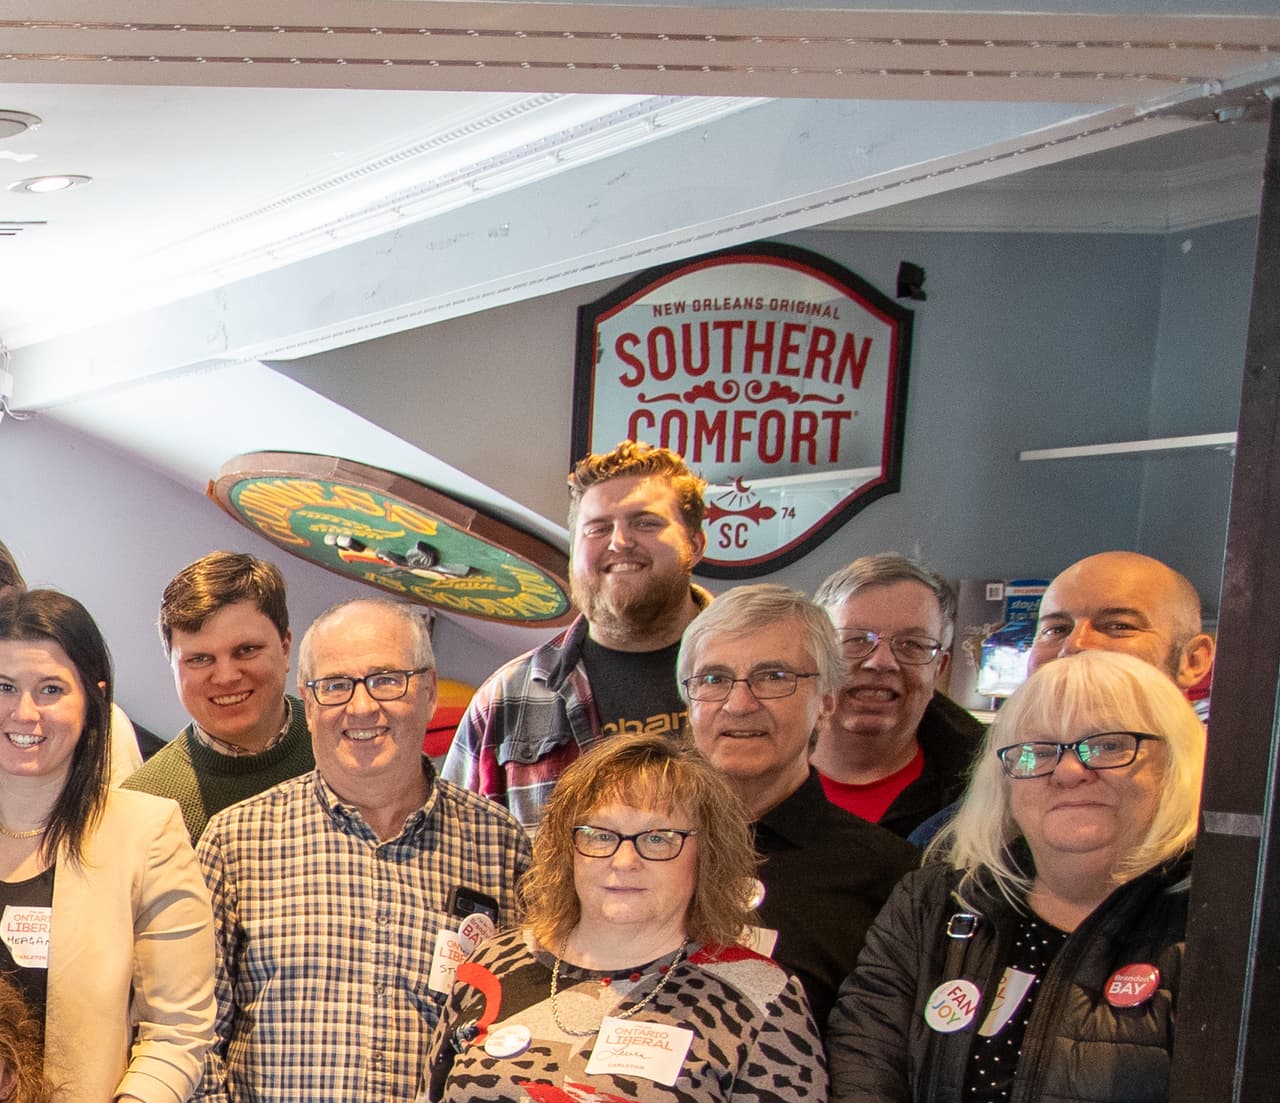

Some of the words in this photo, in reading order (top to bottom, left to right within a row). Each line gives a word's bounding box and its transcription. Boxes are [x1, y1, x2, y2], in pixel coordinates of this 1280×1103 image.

[653, 301, 686, 317] NEW
[692, 297, 764, 313] ORLEANS
[770, 300, 841, 320] ORIGINAL
[615, 320, 873, 390] SOUTHERN
[627, 409, 853, 465] COMFORT
[781, 506, 796, 520] 74
[718, 523, 749, 549] SC
[13, 914, 49, 922] ONTAR
[7, 922, 49, 933] LIBER
[439, 947, 466, 962] LIBE
[1109, 982, 1147, 995] BAY
[947, 986, 977, 1016] FAN
[932, 1000, 961, 1025] JOY
[614, 1027, 669, 1040] ONTARIO
[605, 1035, 673, 1052] LIBERAL
